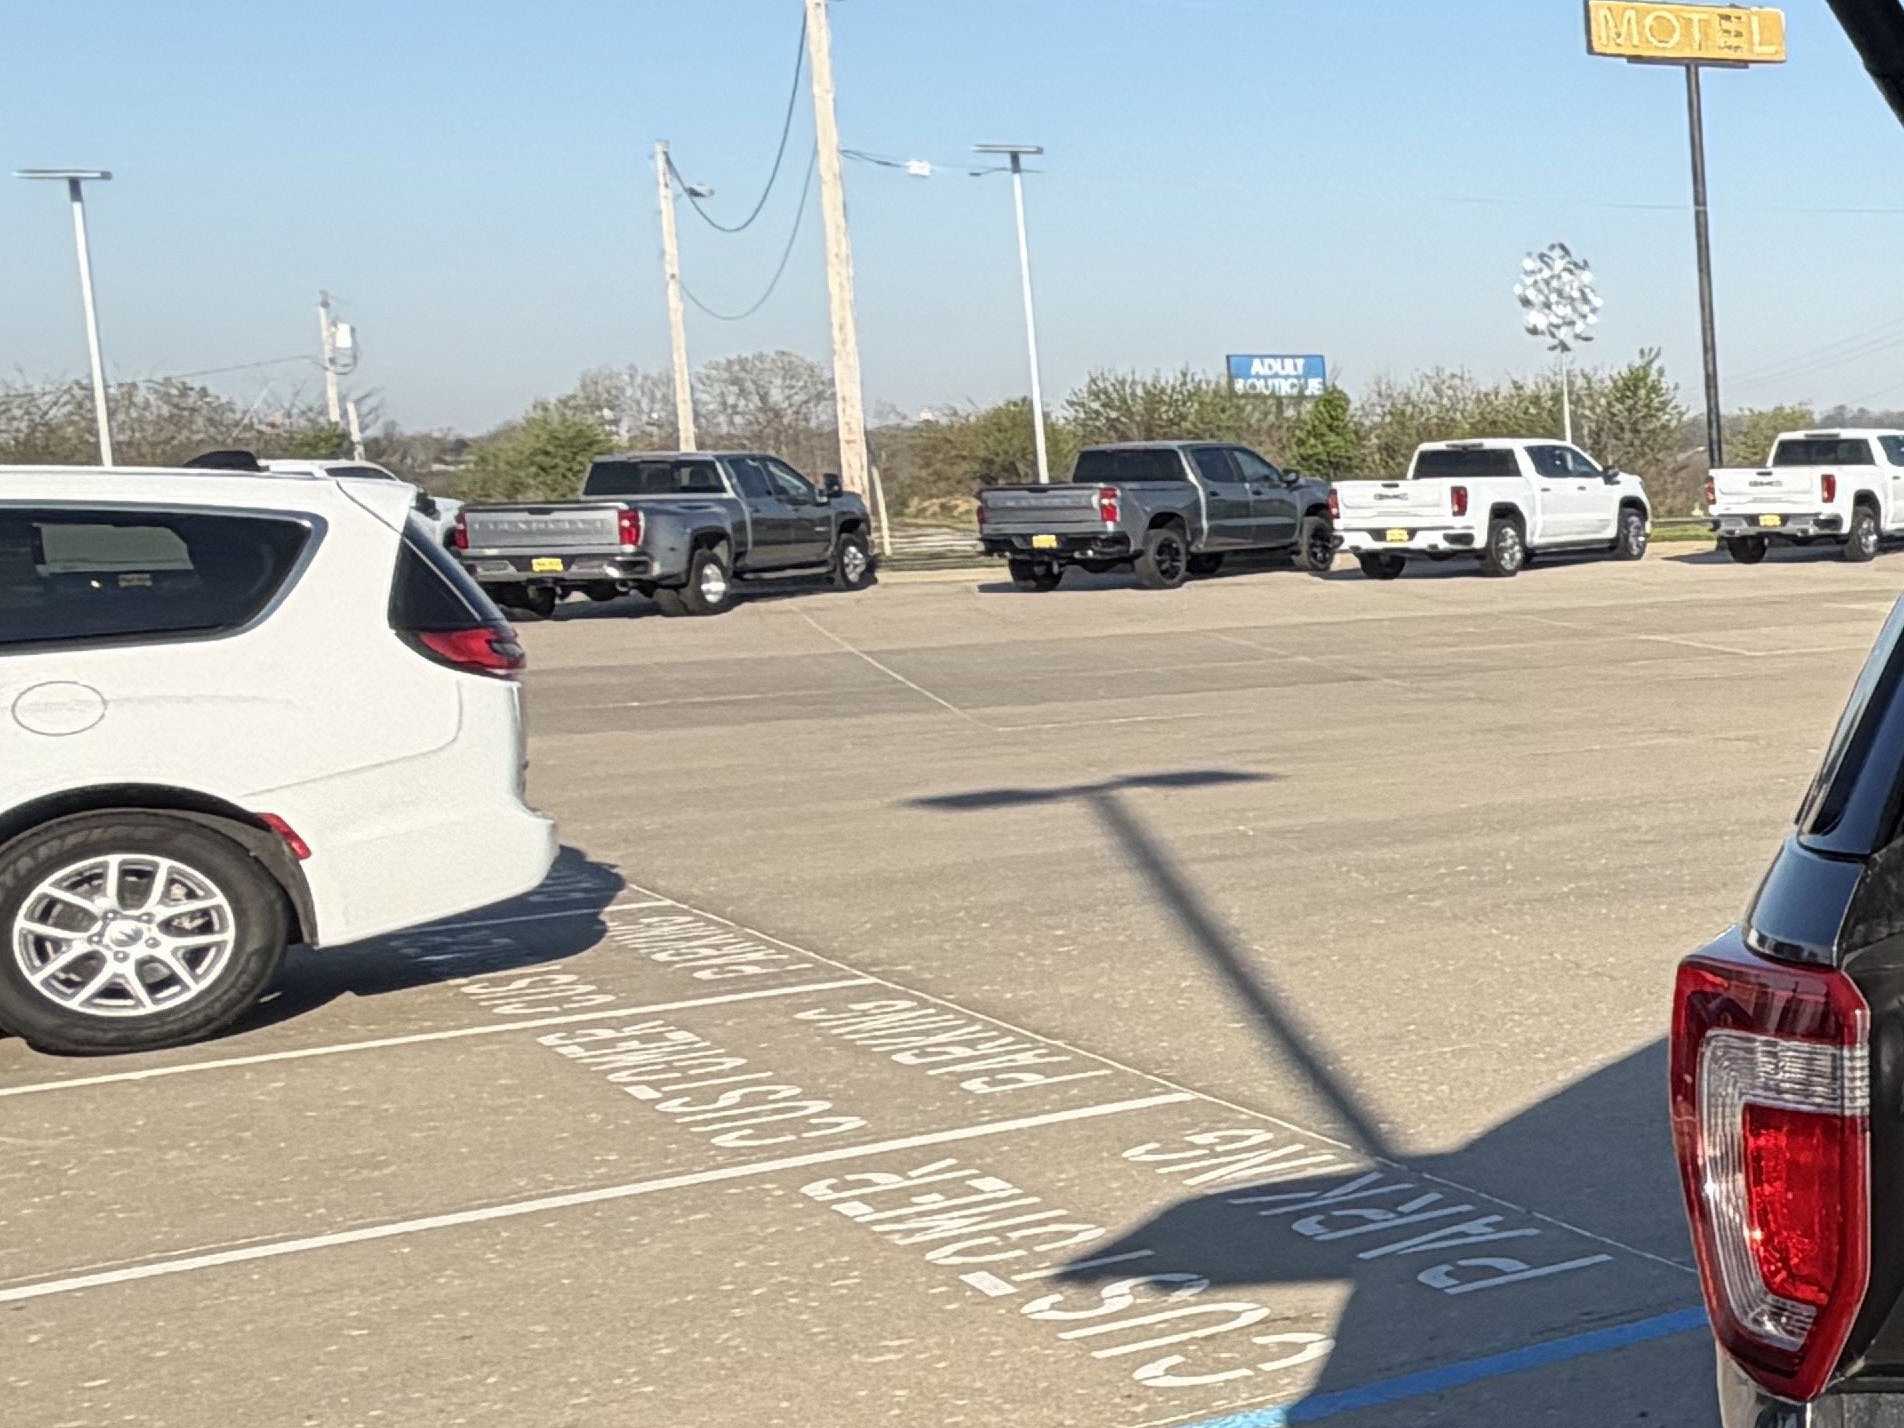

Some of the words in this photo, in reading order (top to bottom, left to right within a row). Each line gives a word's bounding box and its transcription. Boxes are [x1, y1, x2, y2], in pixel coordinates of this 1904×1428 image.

[1600, 8, 1776, 54] MOTEL
[1250, 358, 1305, 375] ADULT
[537, 1020, 867, 1147] CUSTOMER
[793, 999, 1113, 1094] PARKING
[1121, 1128, 1614, 1295] PARKING
[801, 1158, 1336, 1388] CUSTOMER
